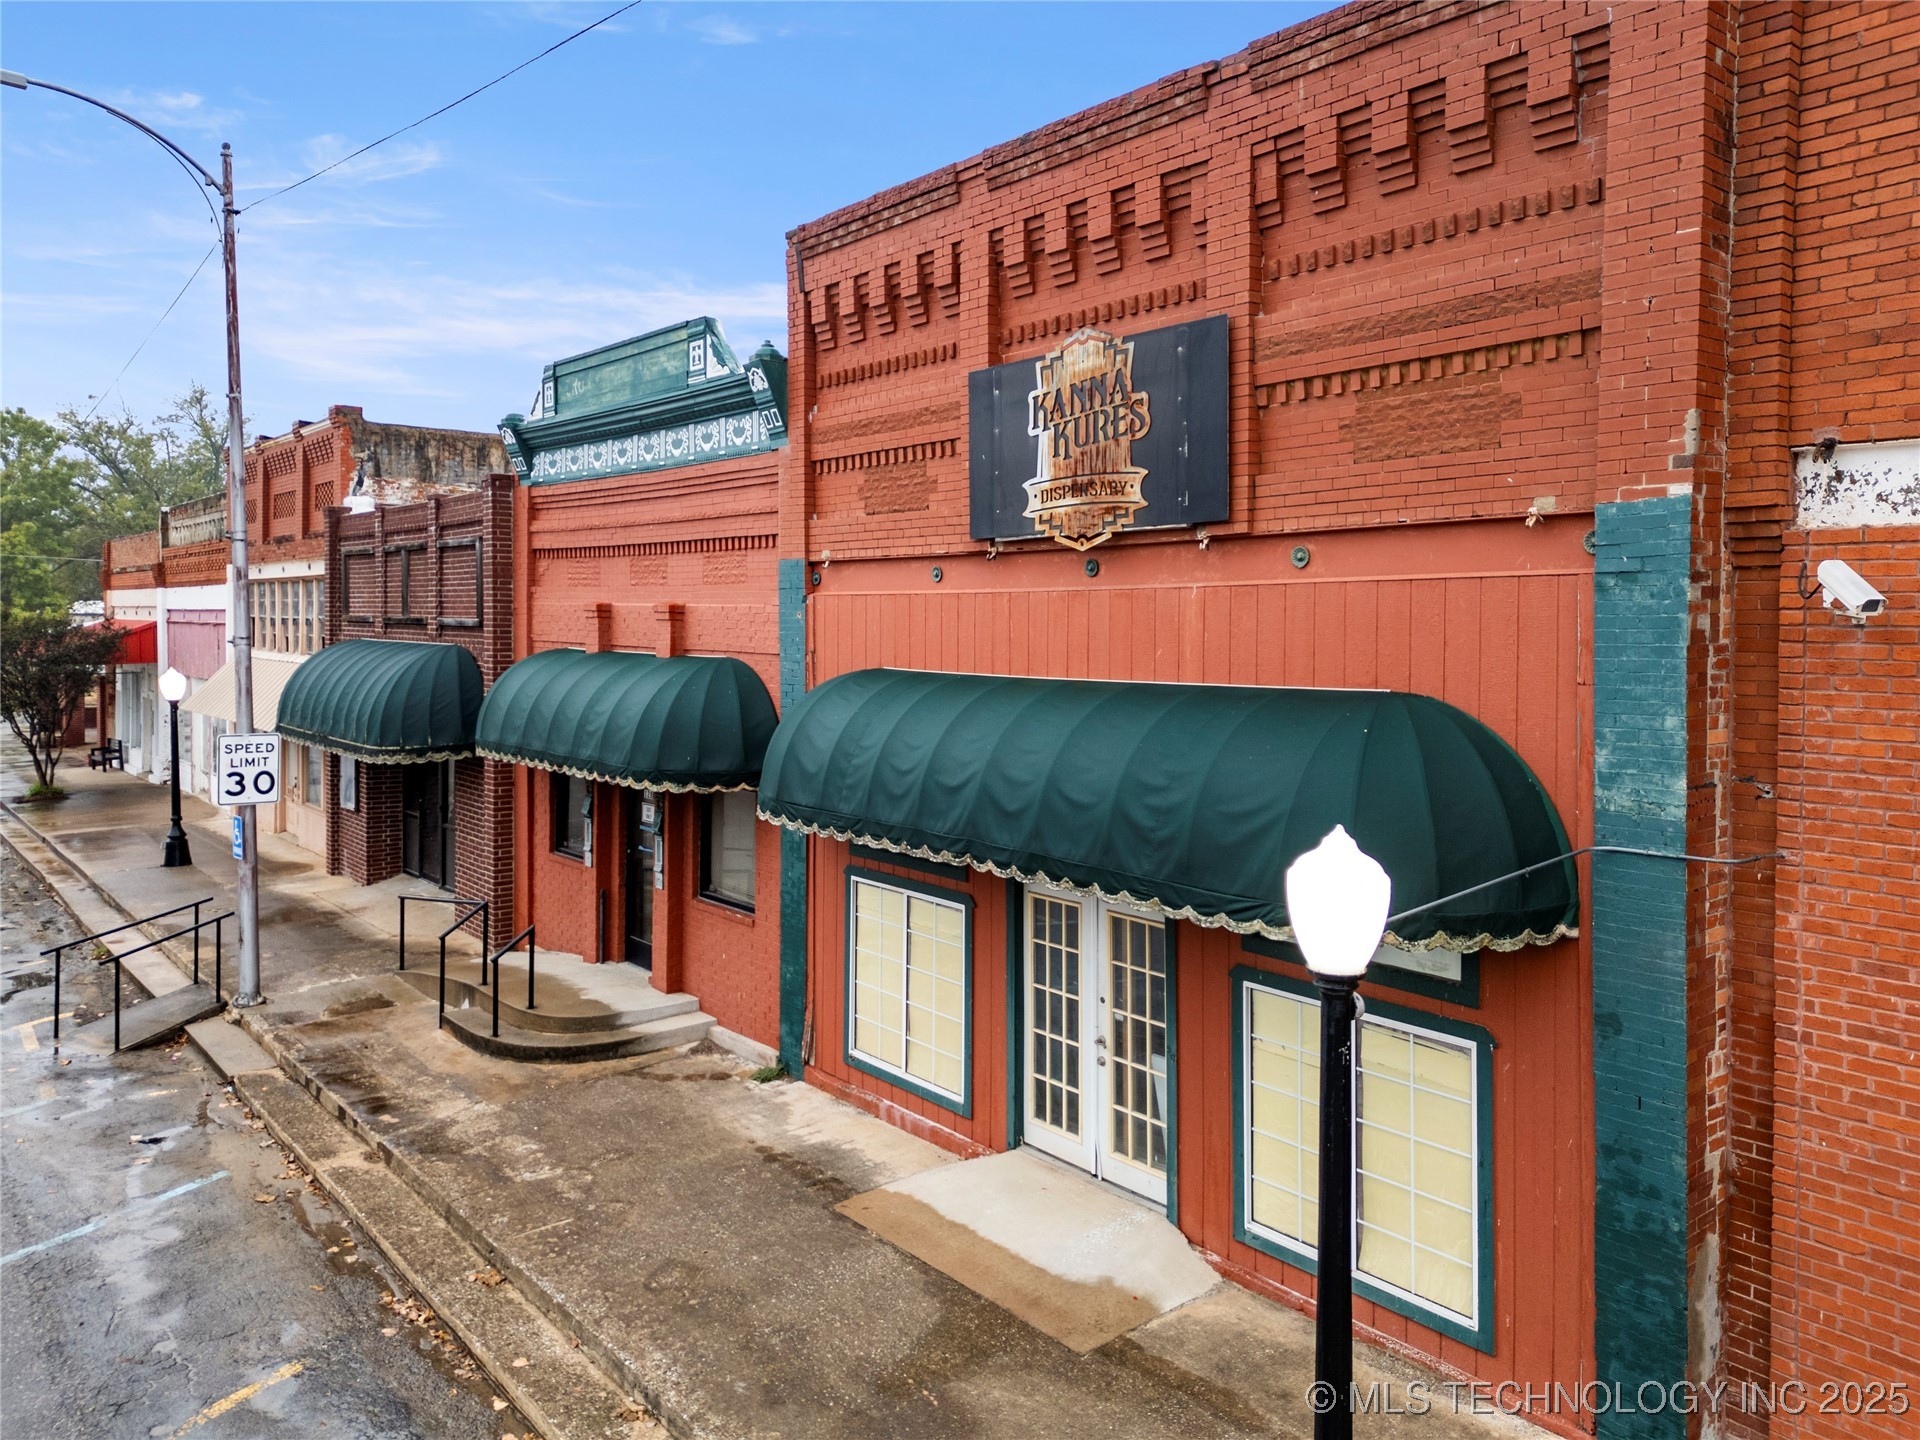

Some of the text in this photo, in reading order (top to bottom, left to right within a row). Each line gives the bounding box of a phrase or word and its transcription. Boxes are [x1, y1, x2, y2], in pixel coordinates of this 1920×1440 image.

[1032, 367, 1131, 431] KANNA
[1052, 397, 1147, 460] KURES
[1040, 480, 1129, 504] DISPENSARY
[224, 743, 275, 754] SPEED
[230, 757, 269, 768] LIMIT
[224, 770, 275, 796] 30
